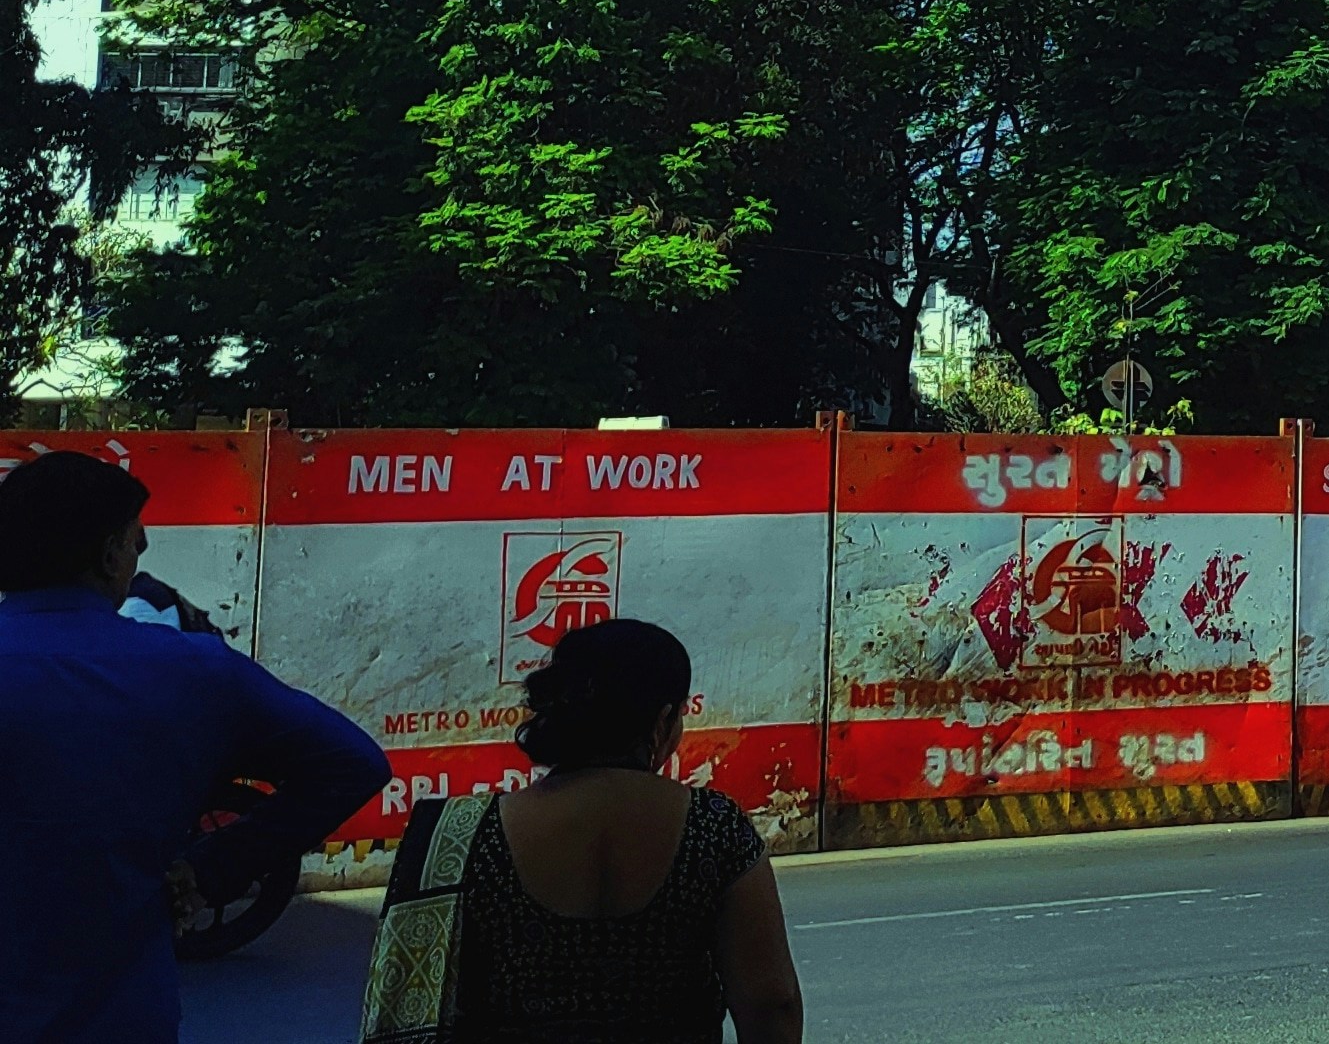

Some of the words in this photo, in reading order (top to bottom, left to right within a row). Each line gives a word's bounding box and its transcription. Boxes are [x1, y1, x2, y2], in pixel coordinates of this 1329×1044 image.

[347, 455, 454, 495] MEN
[500, 454, 563, 492] AT
[585, 453, 703, 490] WORK
[961, 452, 1071, 508] સુરત
[849, 680, 963, 708] METRO
[1111, 665, 1273, 699] PROGRESS
[384, 709, 470, 735] METRO
